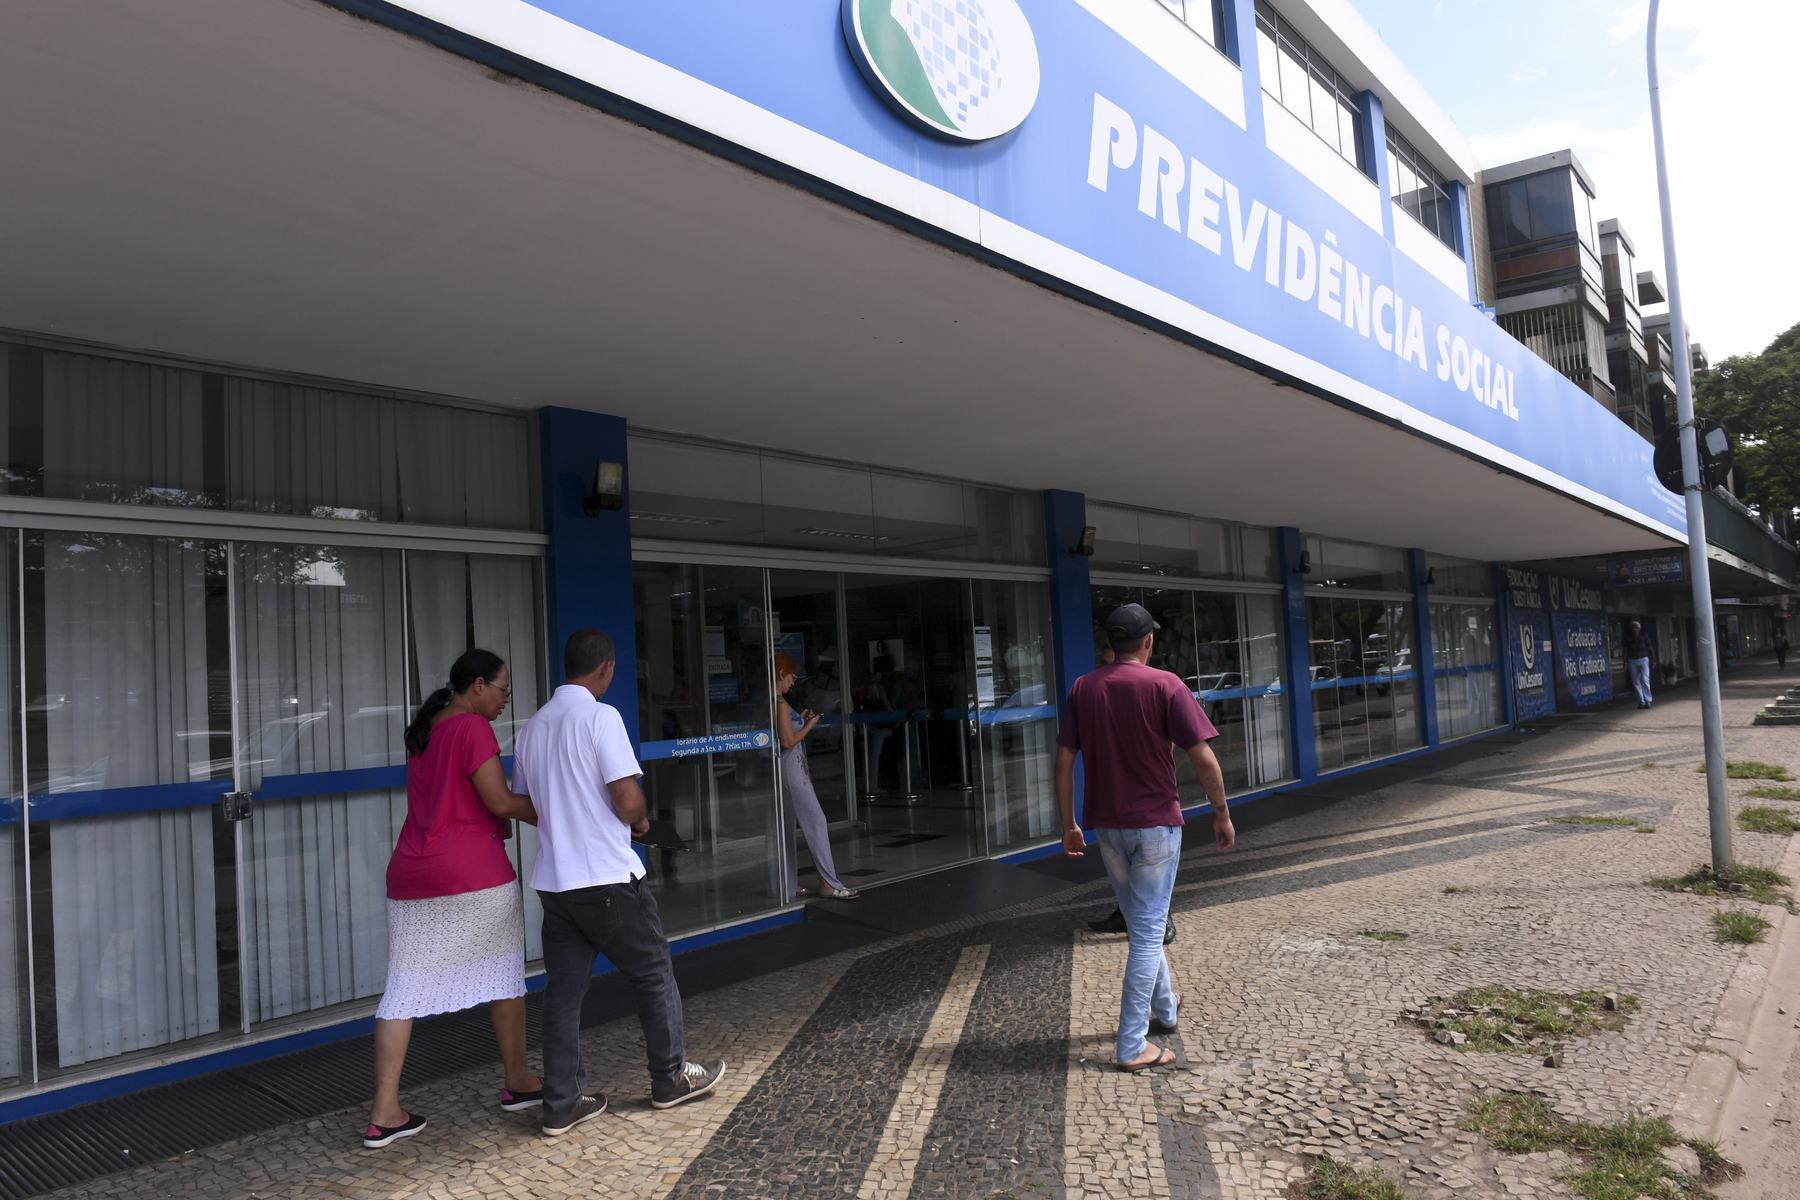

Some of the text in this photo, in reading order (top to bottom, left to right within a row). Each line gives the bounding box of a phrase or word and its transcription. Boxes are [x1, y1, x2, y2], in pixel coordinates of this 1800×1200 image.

[1087, 92, 1519, 422] PREVIDÊNCIA SOCIAL
[1632, 562, 1680, 574] DISTÂNCIA
[1567, 628, 1596, 650] Graduação
[1565, 655, 1606, 677] Pós Graduação
[699, 736, 707, 744] de
[671, 746, 699, 758] Segunda
